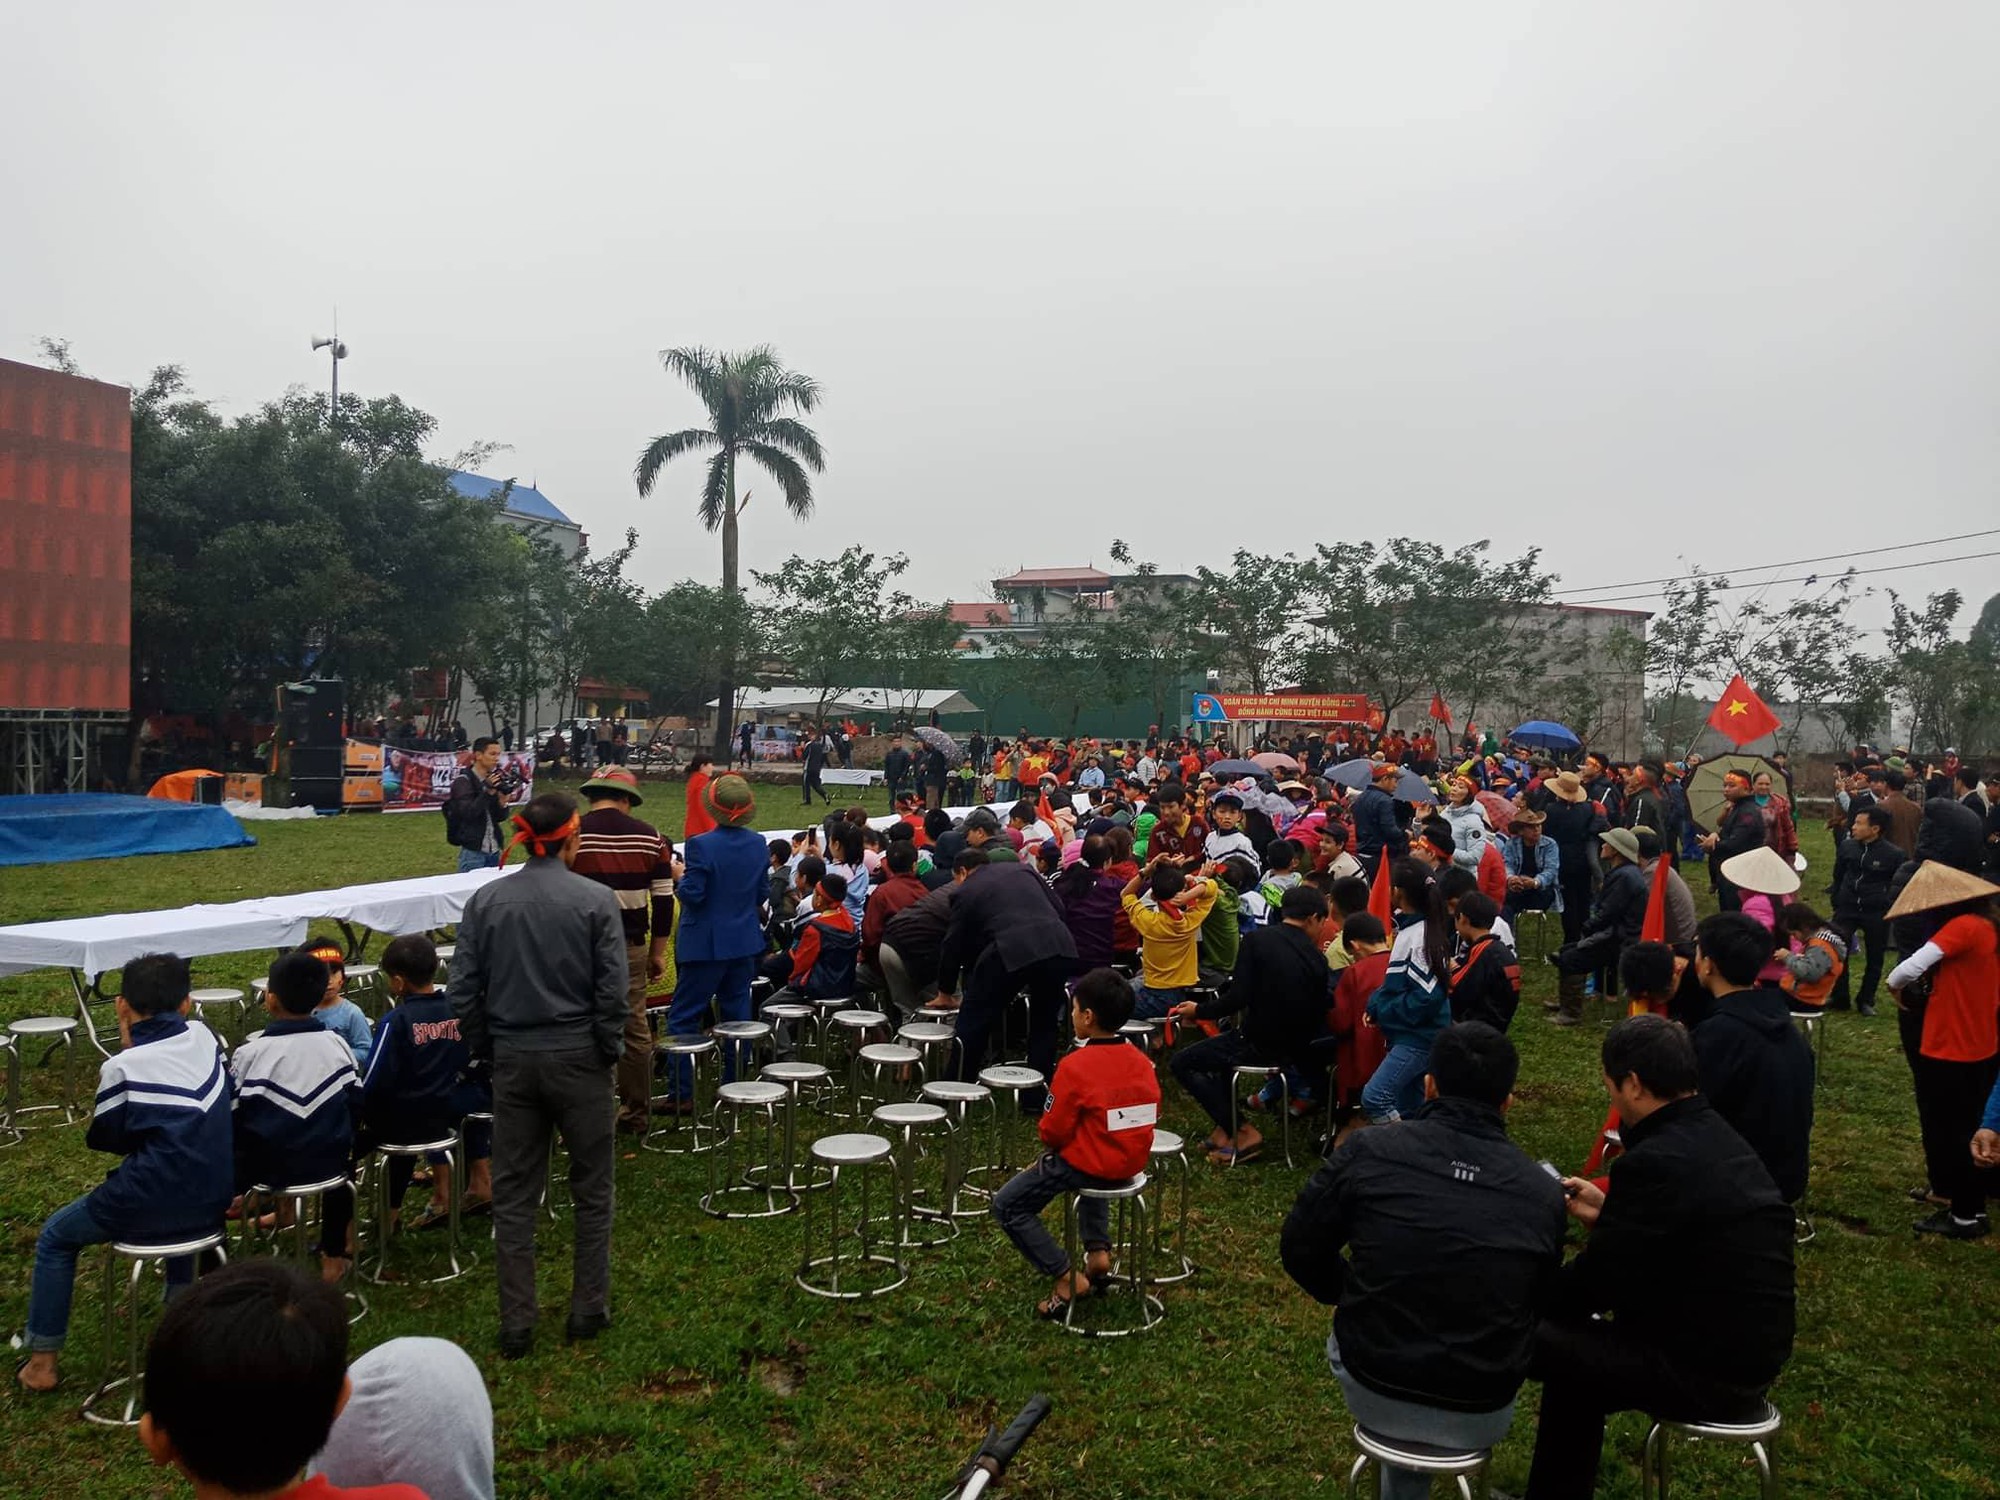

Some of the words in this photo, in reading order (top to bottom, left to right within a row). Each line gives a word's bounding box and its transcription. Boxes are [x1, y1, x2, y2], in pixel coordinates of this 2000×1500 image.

[1281, 698, 1299, 706] MINH
[1293, 708, 1307, 717] U23
[1321, 709, 1338, 718] NAM
